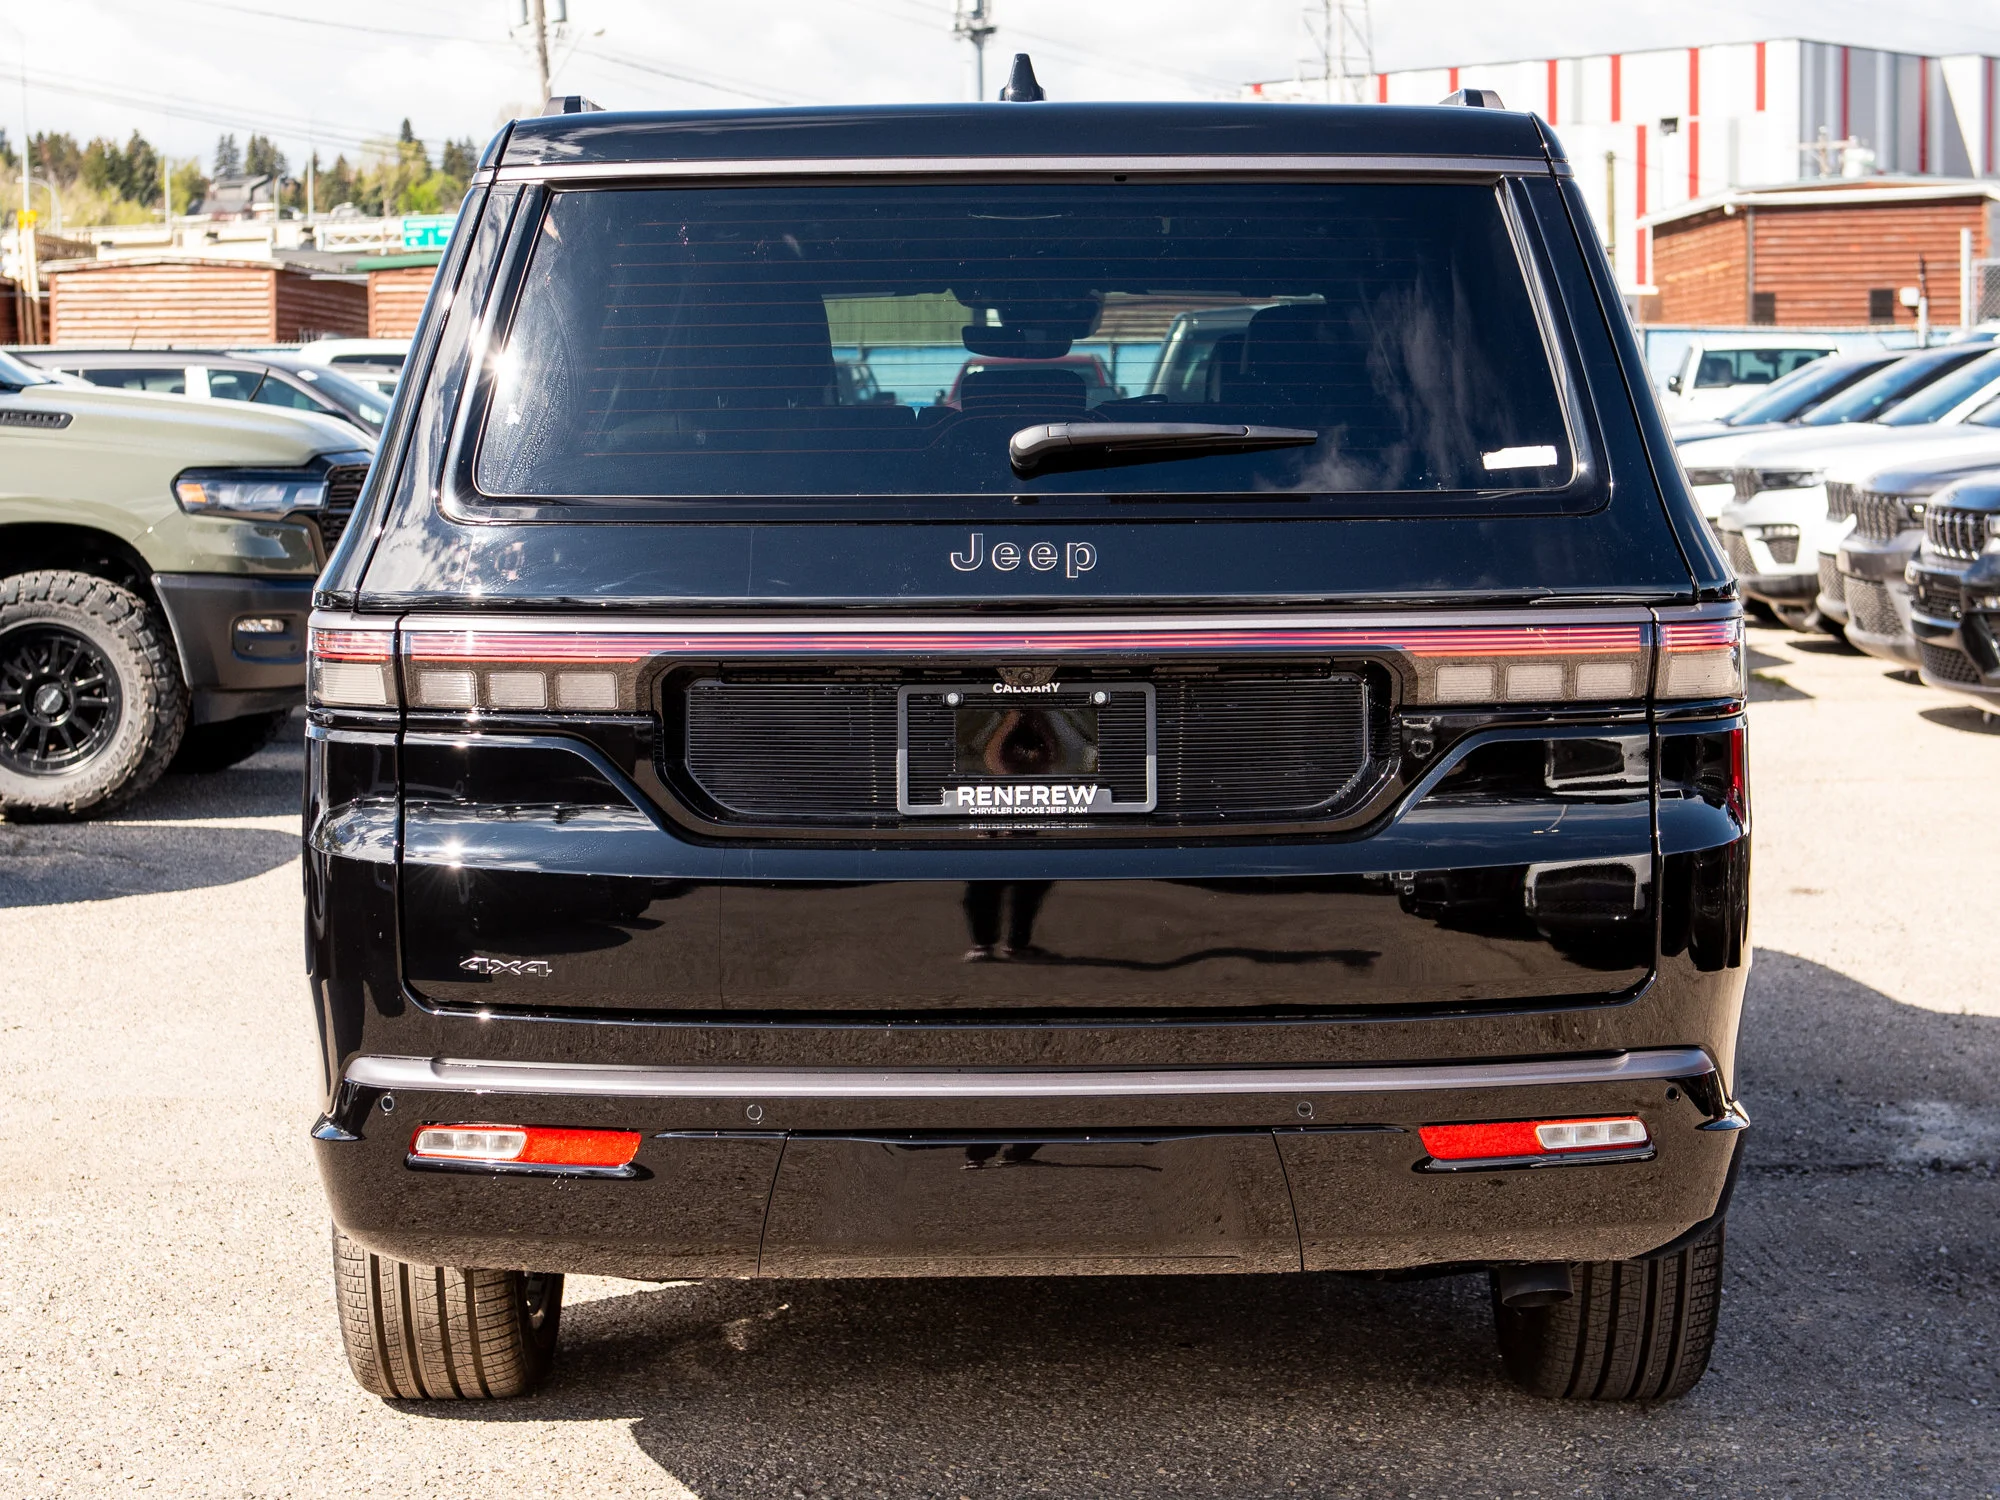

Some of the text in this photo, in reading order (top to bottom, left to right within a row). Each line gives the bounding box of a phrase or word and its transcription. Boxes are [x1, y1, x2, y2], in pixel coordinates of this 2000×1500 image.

[950, 533, 1098, 579] Jeep
[992, 682, 1061, 693] CALGARY
[957, 785, 1098, 806] RENFREW
